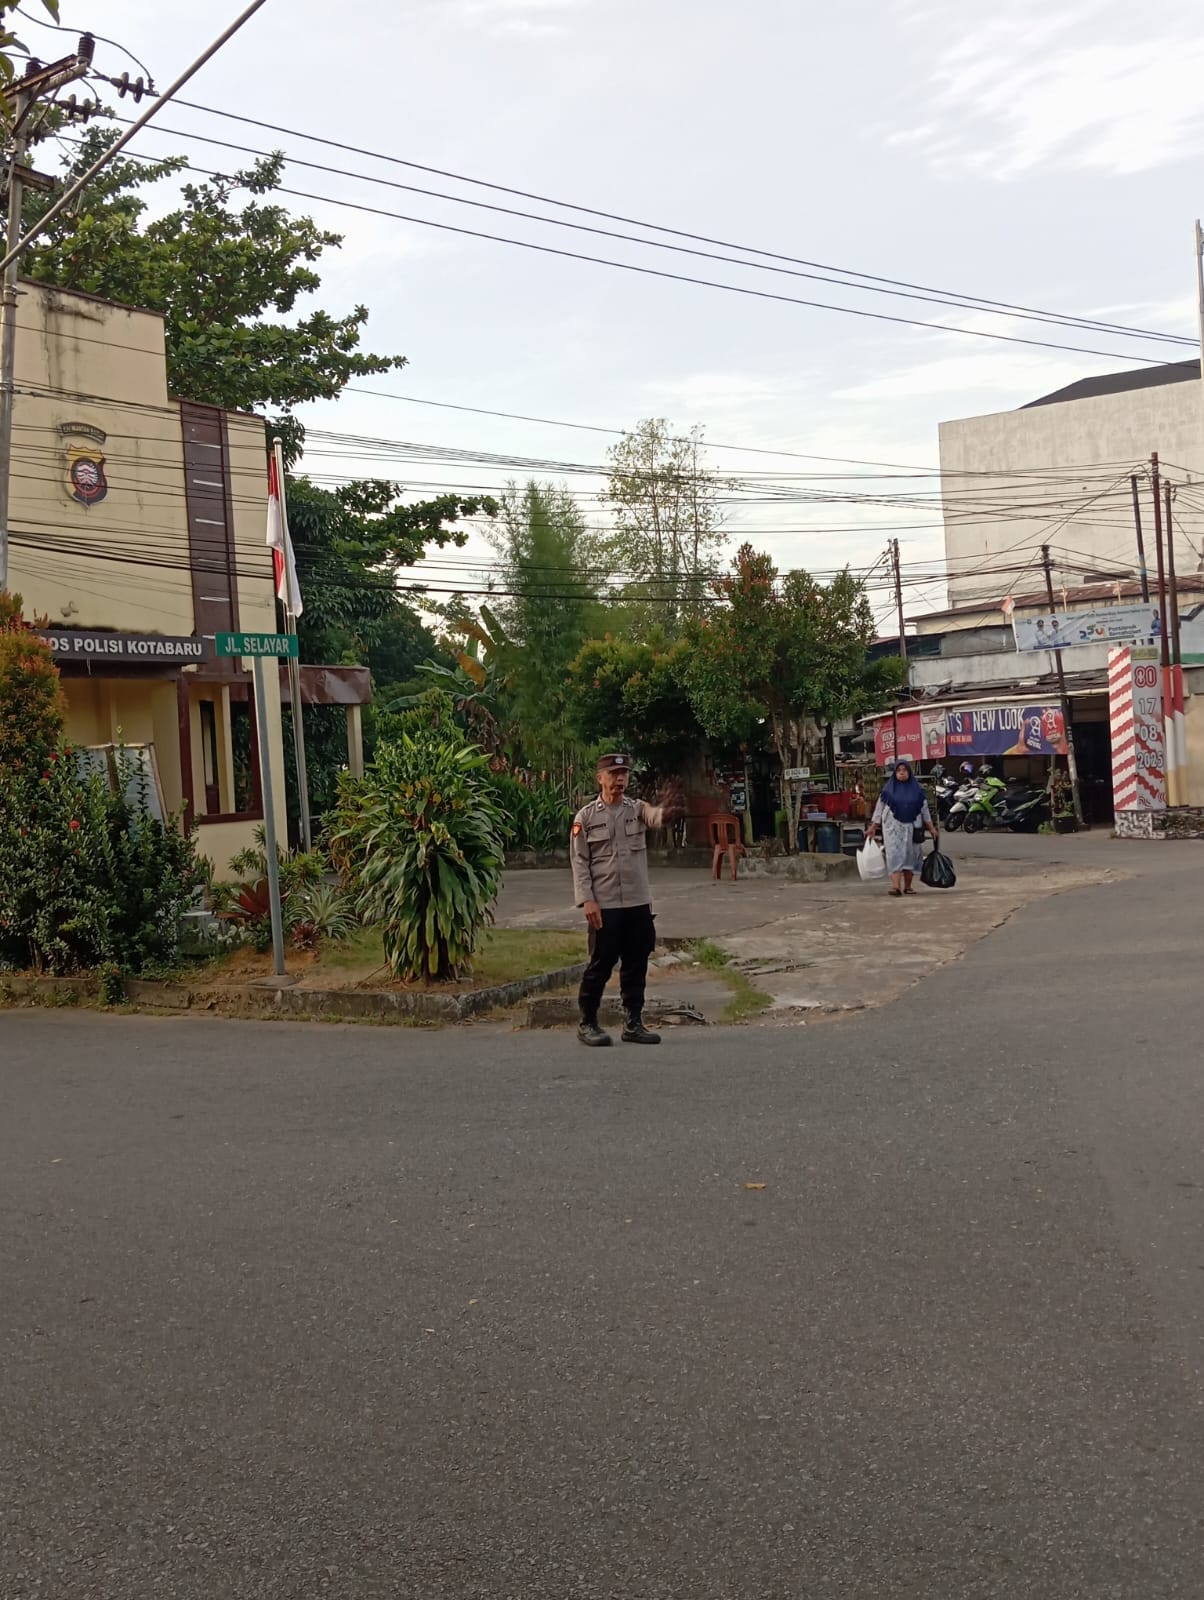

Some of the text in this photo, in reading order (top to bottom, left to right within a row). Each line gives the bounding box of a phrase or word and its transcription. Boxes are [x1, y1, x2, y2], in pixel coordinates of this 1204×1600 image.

[74, 638, 123, 654] POLISI
[127, 640, 202, 656] KOTABARU
[224, 638, 290, 654] JL. SELAYAR
[1134, 665, 1157, 688] 80
[1138, 697, 1156, 715] 17
[973, 709, 996, 732] NEW
[999, 707, 1025, 730] LOOK
[1140, 724, 1158, 742] 08
[1136, 751, 1165, 770] 2025
